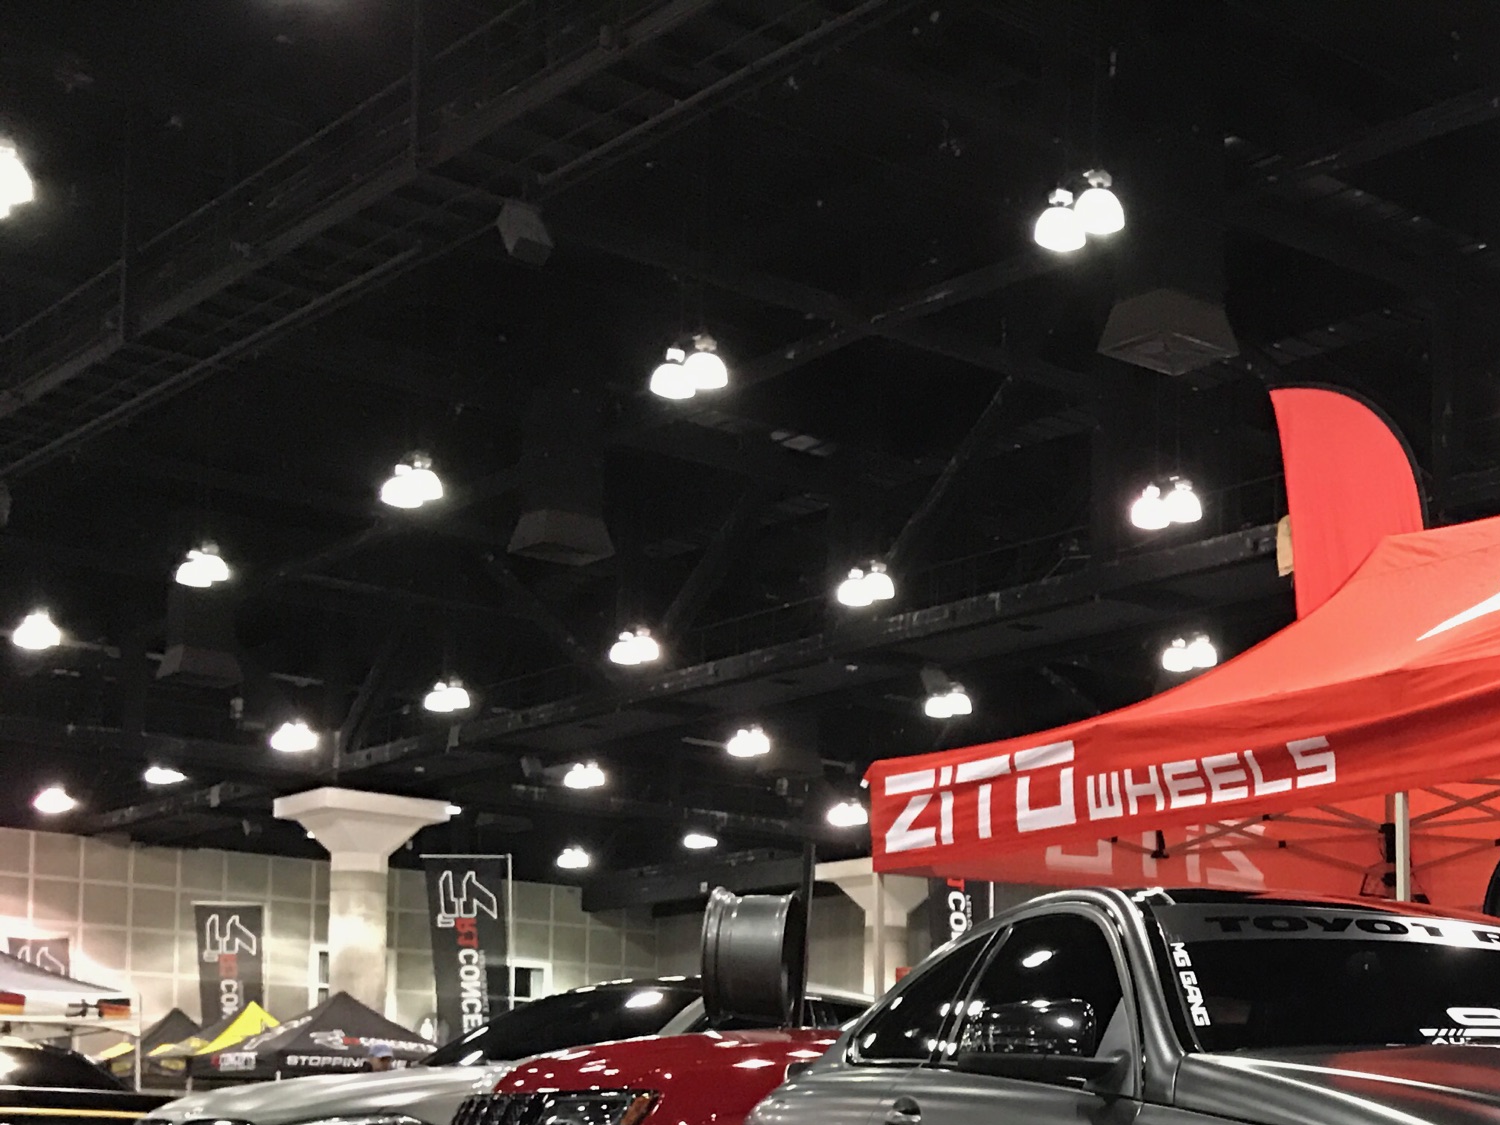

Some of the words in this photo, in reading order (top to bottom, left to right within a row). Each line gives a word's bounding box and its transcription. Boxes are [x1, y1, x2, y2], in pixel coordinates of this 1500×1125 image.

[885, 740, 1077, 854] ZITO
[1086, 735, 1337, 821] WHEELS
[1179, 970, 1211, 1026] GANG
